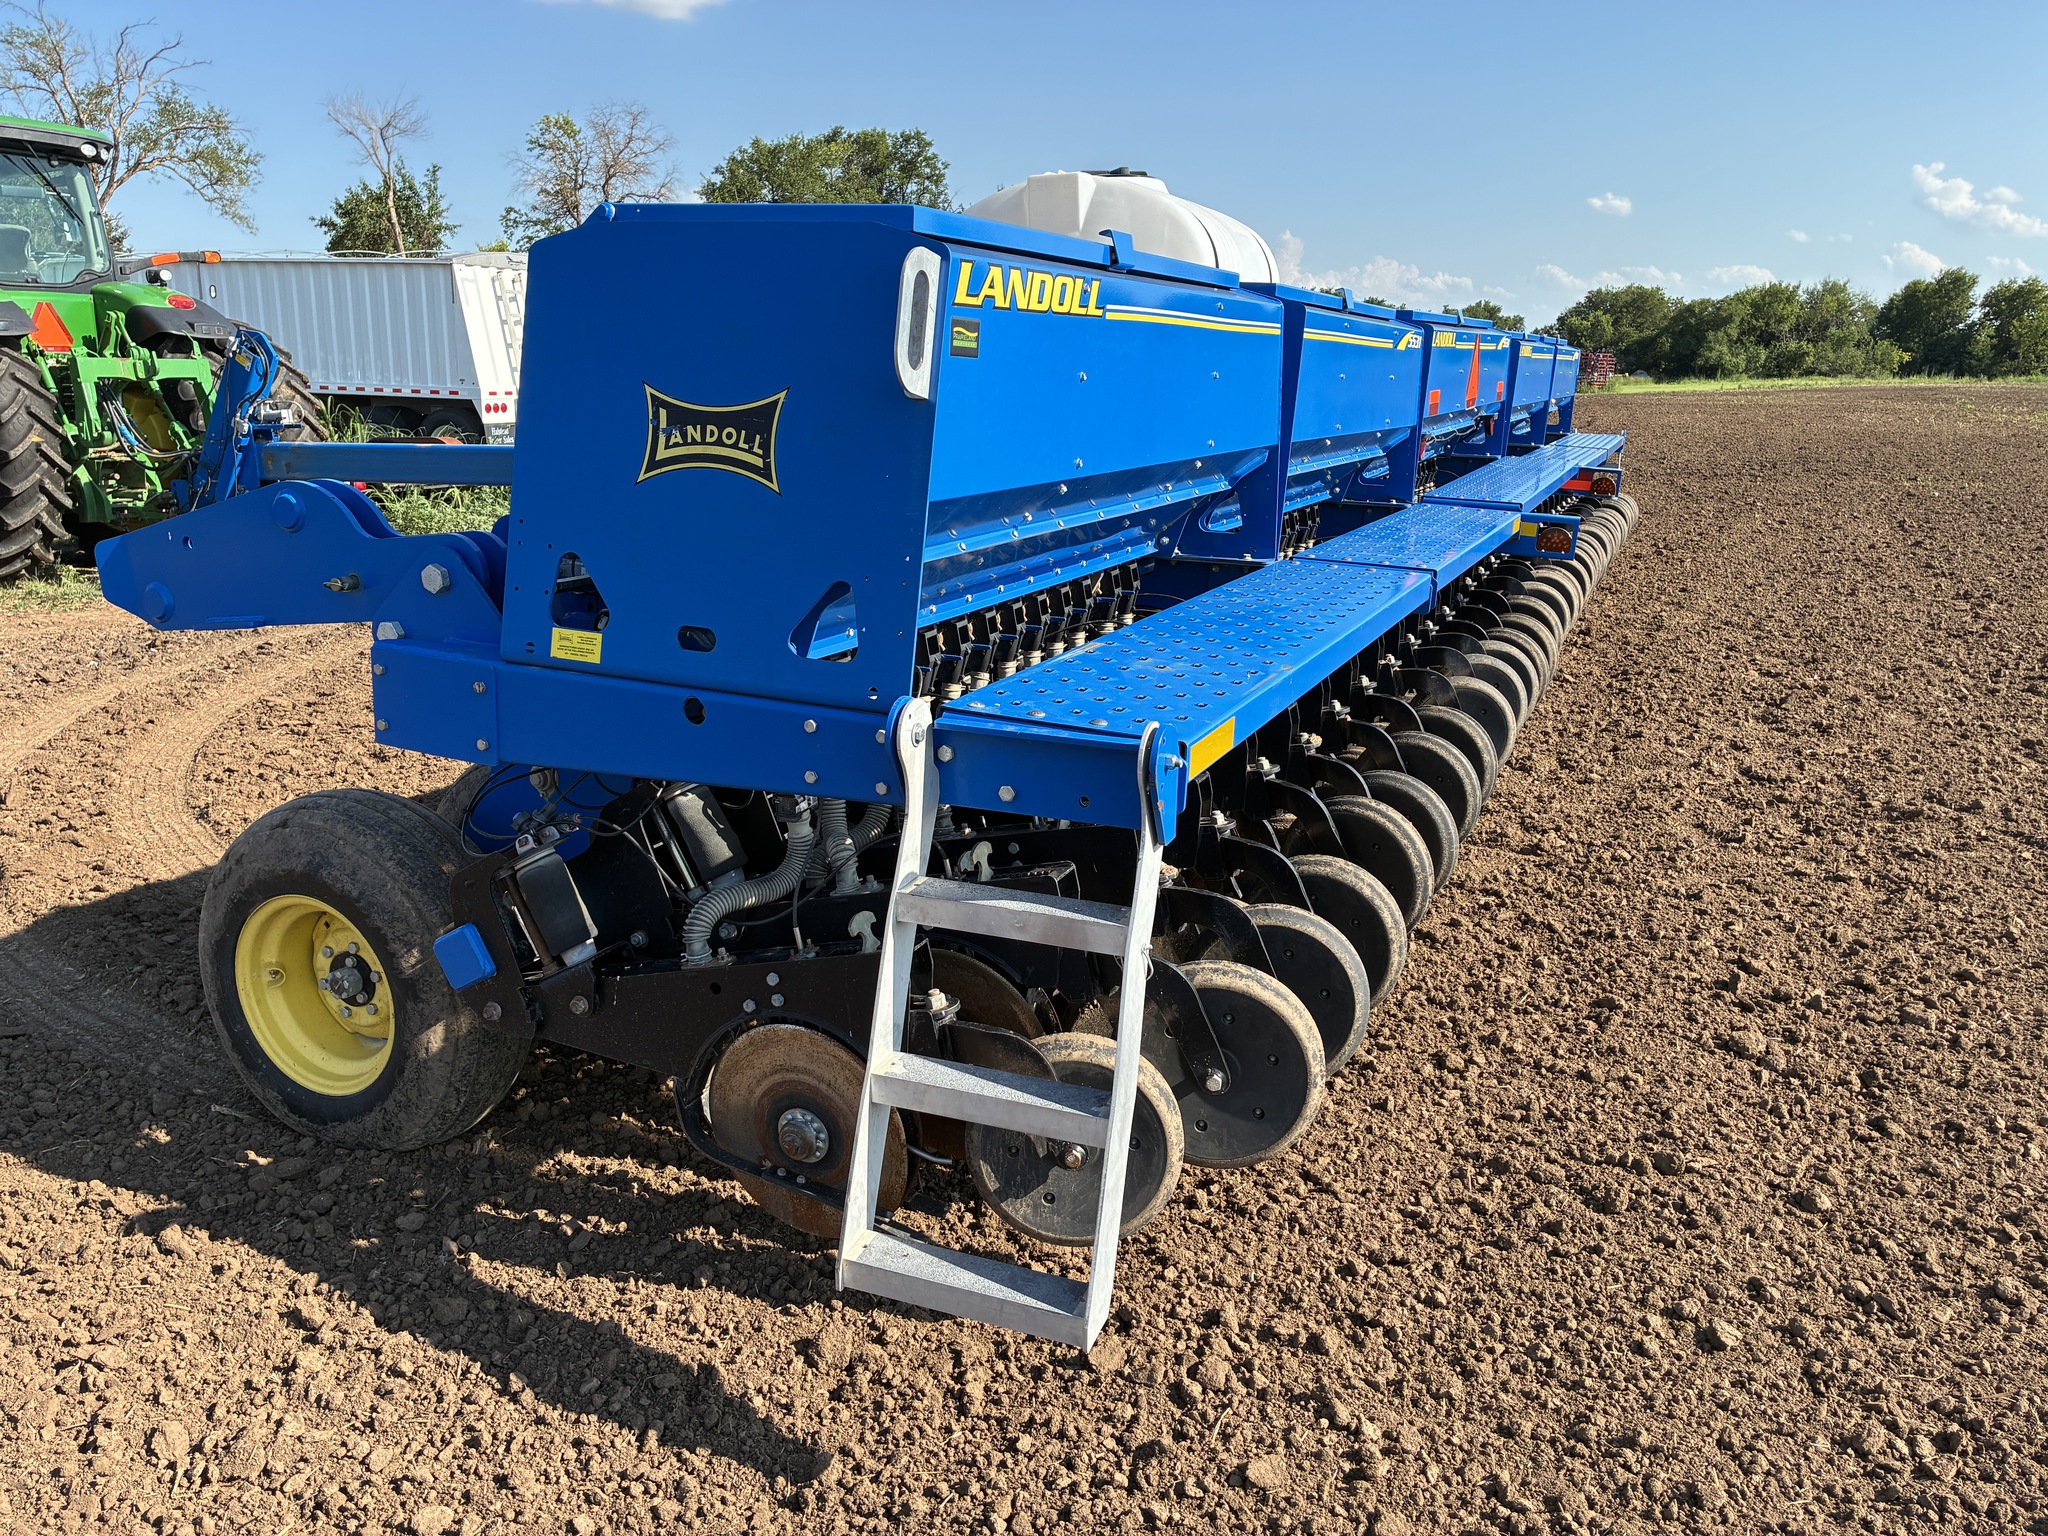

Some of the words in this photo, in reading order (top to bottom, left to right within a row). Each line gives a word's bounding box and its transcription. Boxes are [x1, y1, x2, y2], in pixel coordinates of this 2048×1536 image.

[953, 259, 1104, 317] LANDOLL
[1432, 330, 1457, 348] LANDOLL
[502, 435, 515, 444] Sales
[655, 407, 764, 468] LANDOLL
